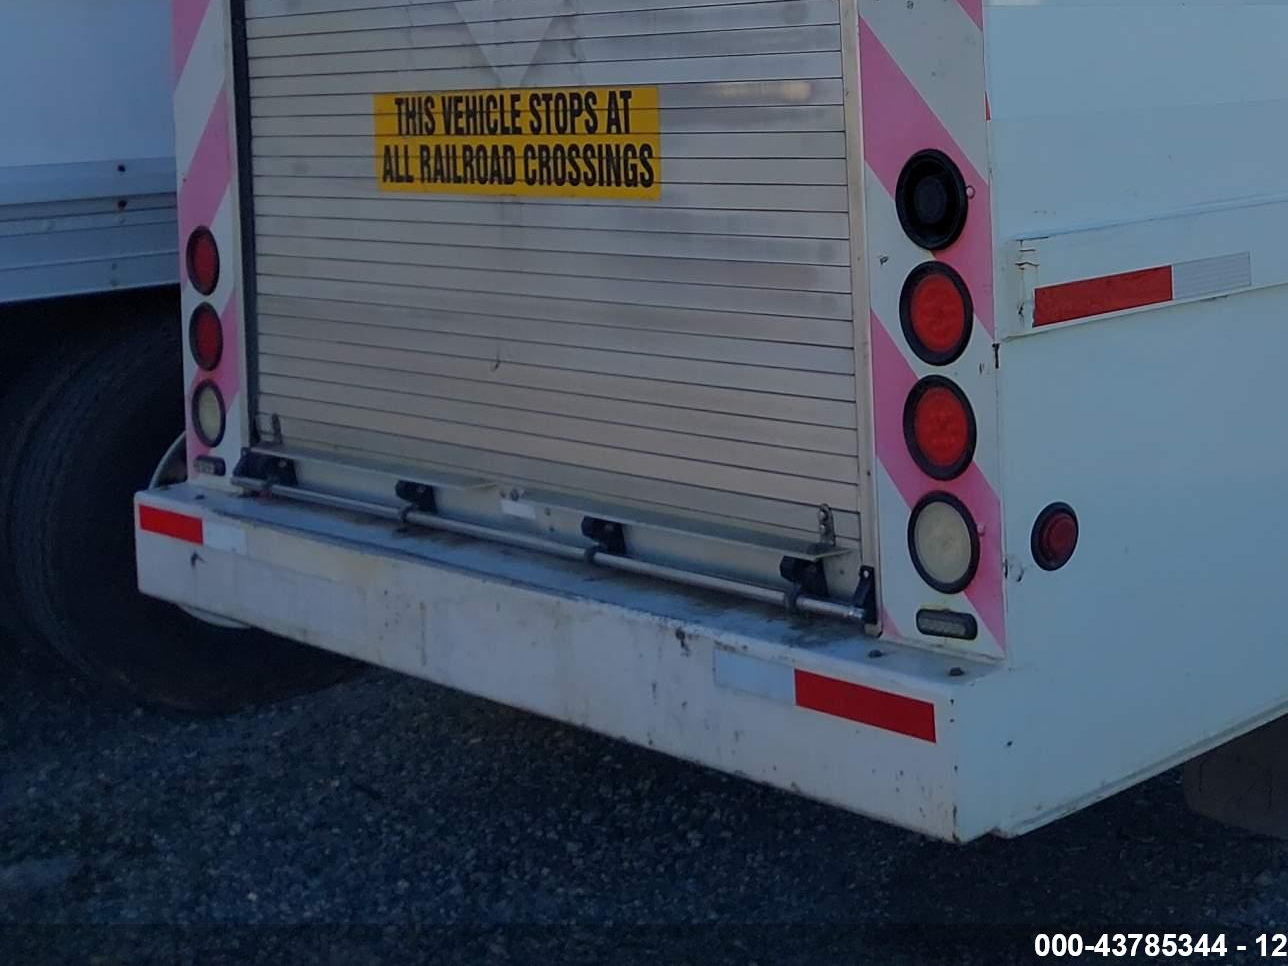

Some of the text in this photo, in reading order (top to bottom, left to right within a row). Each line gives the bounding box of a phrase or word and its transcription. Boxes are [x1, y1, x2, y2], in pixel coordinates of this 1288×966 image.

[394, 90, 632, 136] THIS VEHICLE STOPS AT
[382, 143, 654, 188] ALL RAILROAD CROSSINGS
